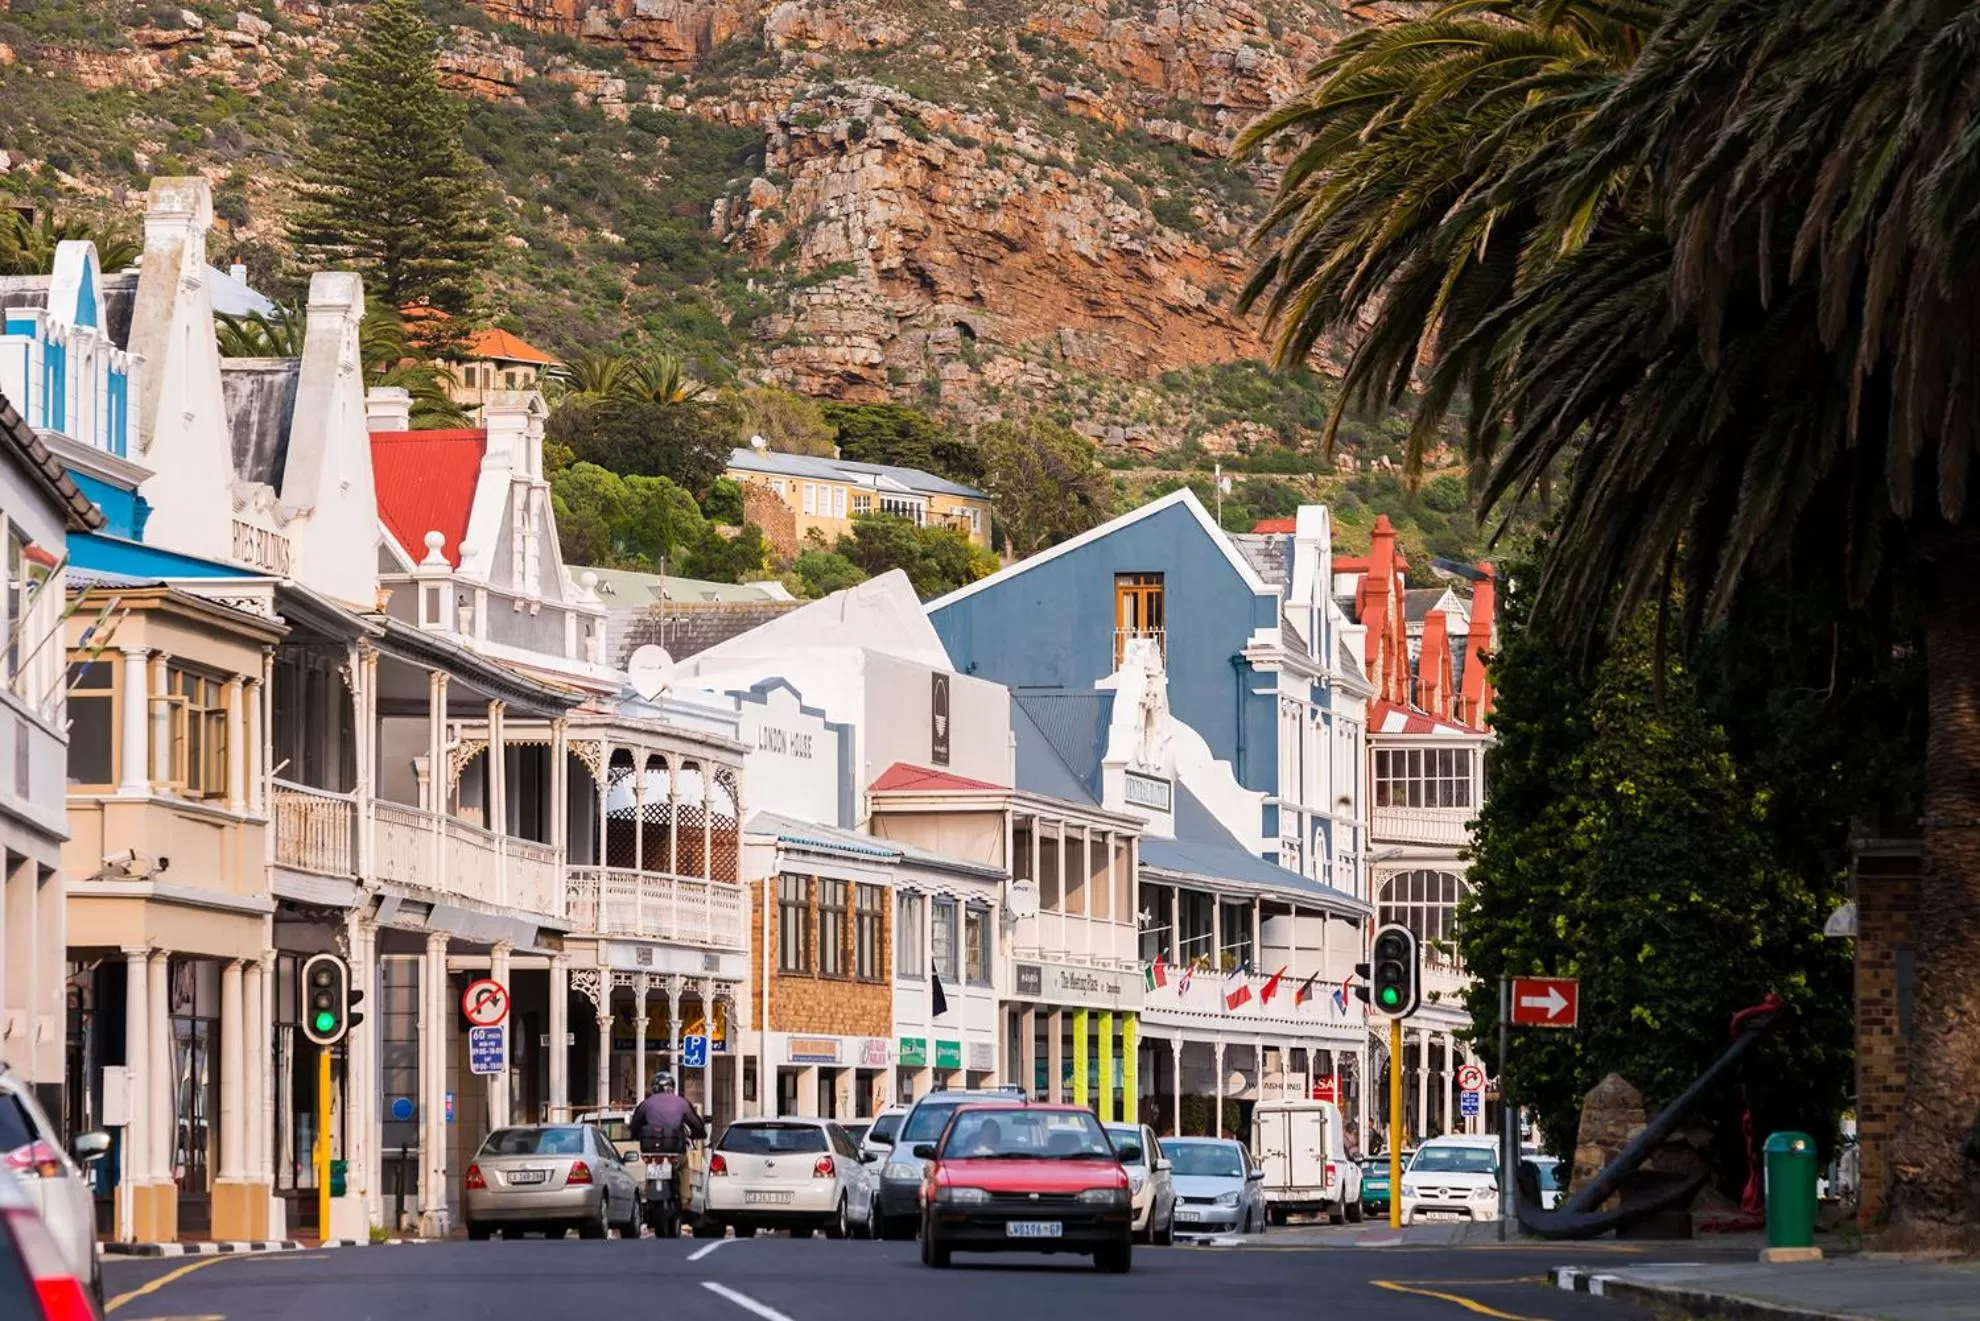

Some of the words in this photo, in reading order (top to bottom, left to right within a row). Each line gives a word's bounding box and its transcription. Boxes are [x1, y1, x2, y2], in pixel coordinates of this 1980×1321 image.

[758, 723, 787, 755] LONDON
[790, 730, 813, 760] HOUSE
[473, 1030, 485, 1041] 60
[691, 1036, 701, 1050] P
